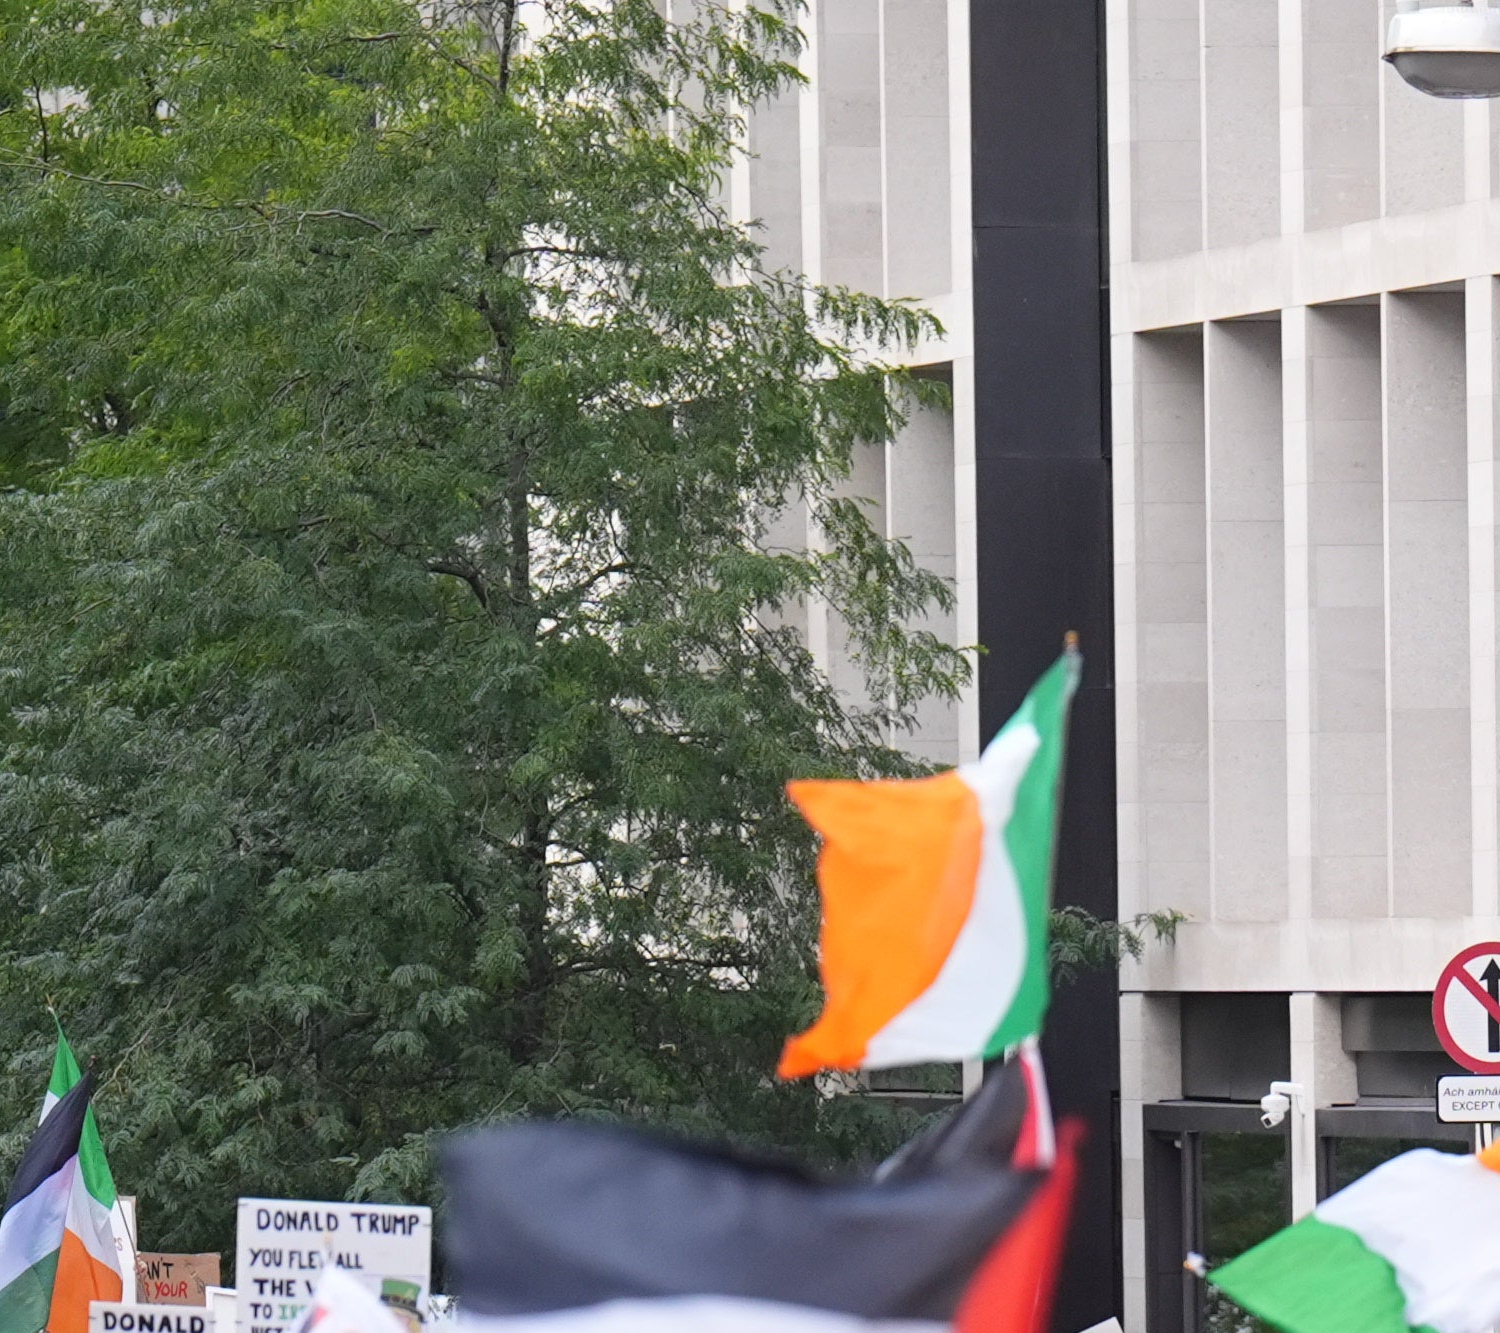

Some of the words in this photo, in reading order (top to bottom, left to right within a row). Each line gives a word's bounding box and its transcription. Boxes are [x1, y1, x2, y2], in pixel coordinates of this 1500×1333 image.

[1443, 1087, 1464, 1097] Ach
[1452, 1101, 1494, 1112] EXCEPT
[257, 1209, 339, 1232] DONALD
[351, 1213, 420, 1236] TRUMP
[249, 1248, 283, 1268] YOU
[336, 1252, 363, 1269] ALL
[155, 1281, 188, 1298] YOUR
[253, 1279, 296, 1297] THE
[250, 1303, 273, 1319] TO
[104, 1311, 205, 1333] DONALD
